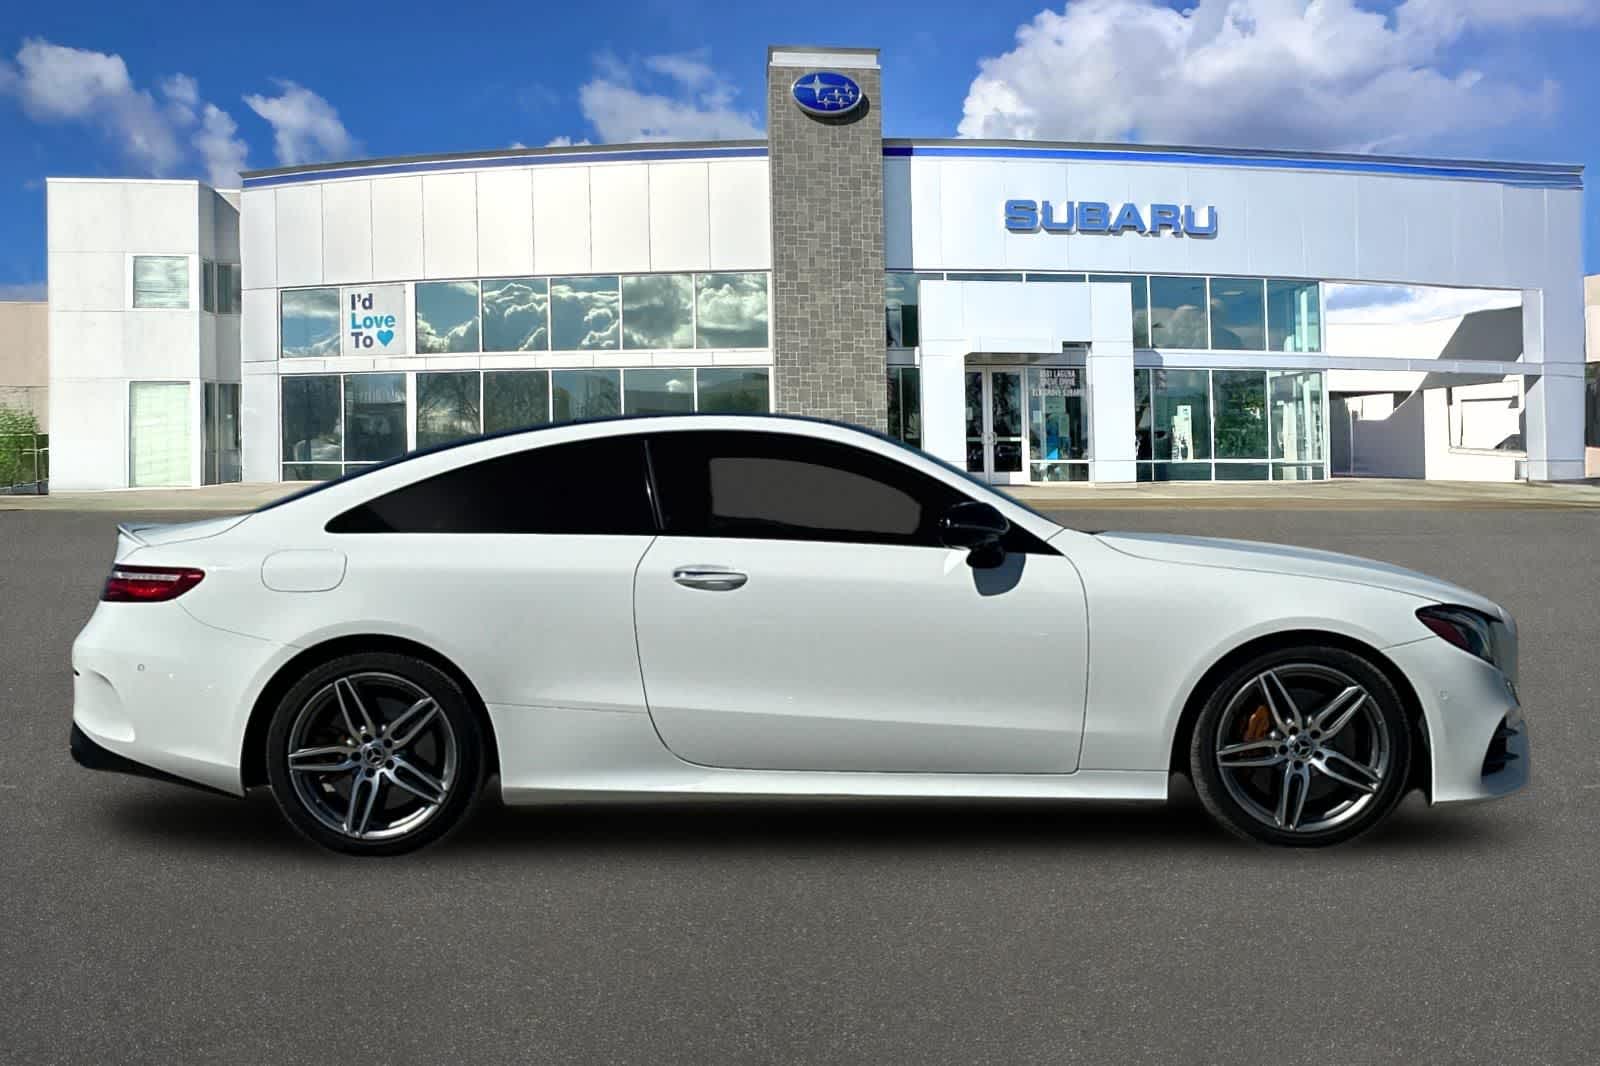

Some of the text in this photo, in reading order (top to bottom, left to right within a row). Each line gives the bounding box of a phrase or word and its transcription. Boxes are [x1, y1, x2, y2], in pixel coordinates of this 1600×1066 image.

[1005, 199, 1217, 237] SUBARU
[351, 293, 373, 310] I'd
[351, 312, 396, 329] Love
[351, 331, 374, 348] To
